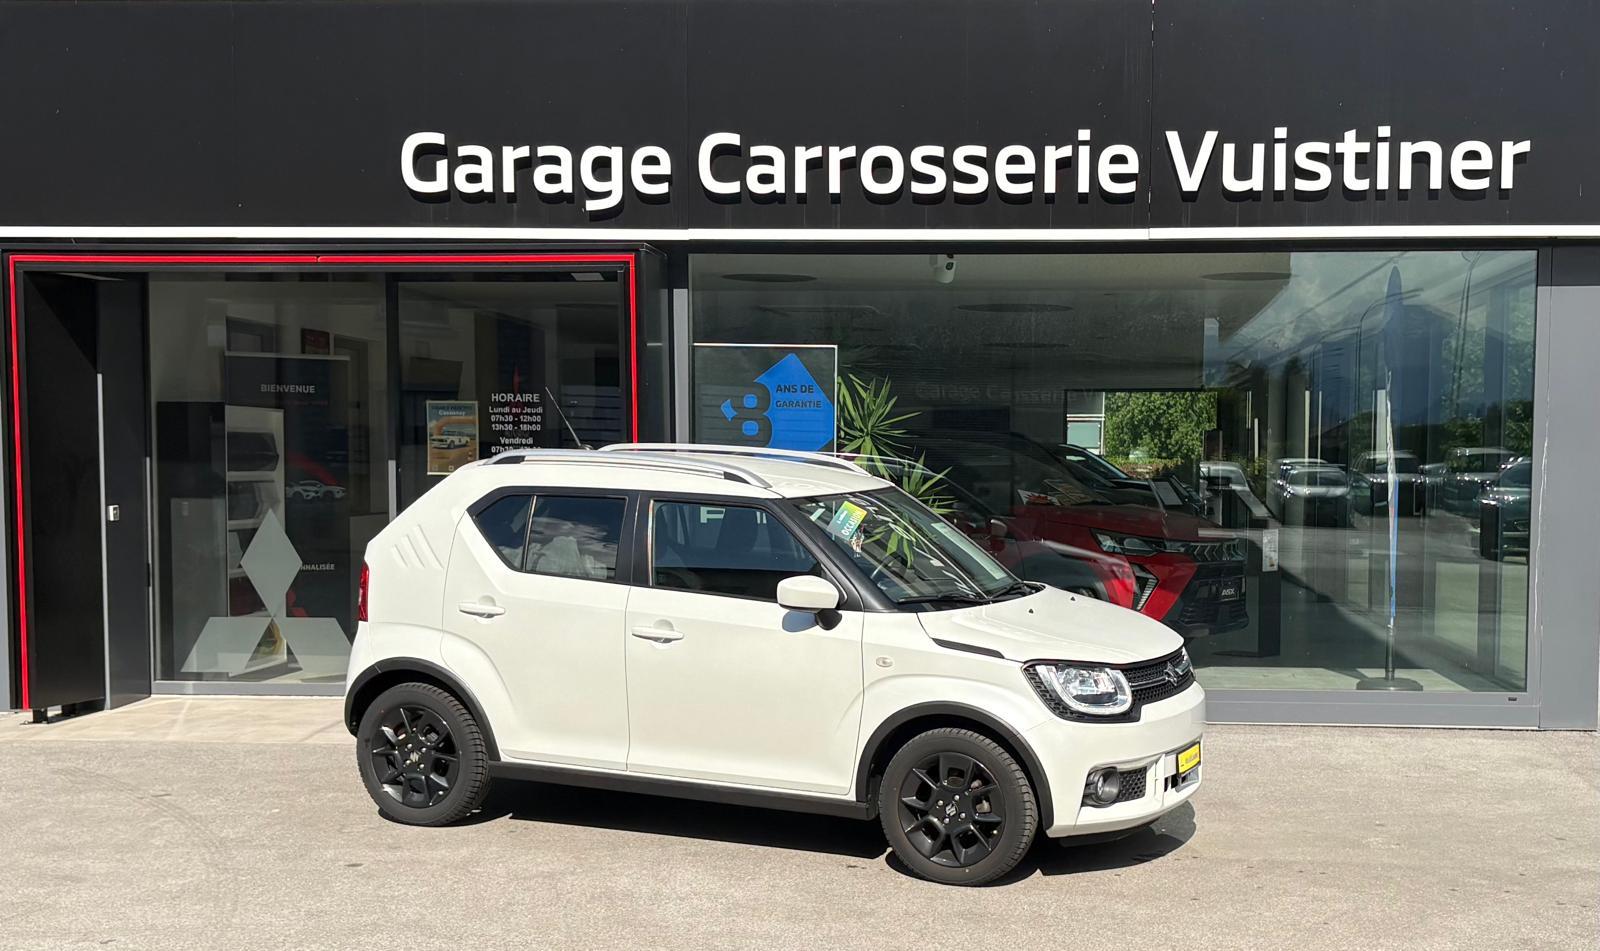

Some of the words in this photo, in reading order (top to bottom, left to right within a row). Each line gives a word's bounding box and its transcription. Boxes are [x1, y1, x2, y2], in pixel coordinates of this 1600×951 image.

[401, 132, 671, 211] Garage
[699, 129, 1139, 195] Carrosserie
[1166, 126, 1531, 192] Vuistiner
[260, 384, 316, 393] BIENVENUE
[776, 384, 798, 393] ANS
[800, 384, 814, 393] DE
[491, 393, 540, 402] HORAIRE
[775, 400, 822, 409] GARANTIE
[499, 437, 534, 445] Vendredi
